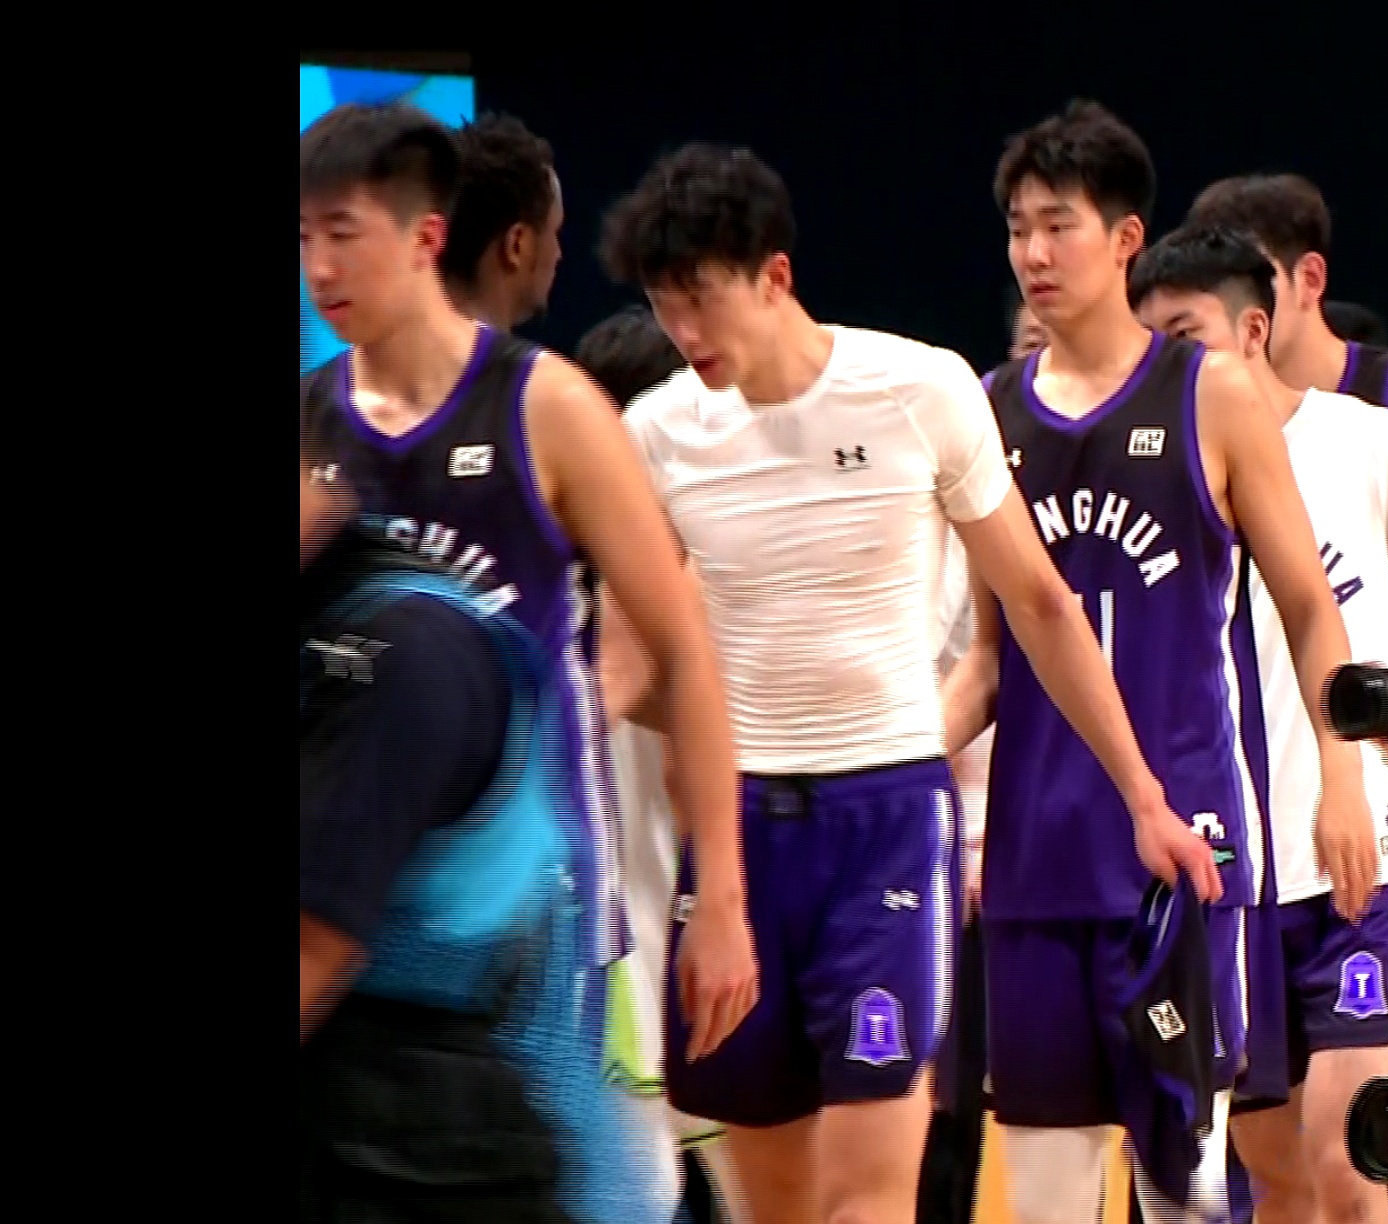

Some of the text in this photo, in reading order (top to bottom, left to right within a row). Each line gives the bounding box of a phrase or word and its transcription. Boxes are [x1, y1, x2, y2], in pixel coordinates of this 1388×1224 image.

[386, 516, 522, 618] GHUA
[1033, 487, 1180, 587] NGHUA
[1319, 541, 1364, 606] UA
[1353, 973, 1371, 999] T
